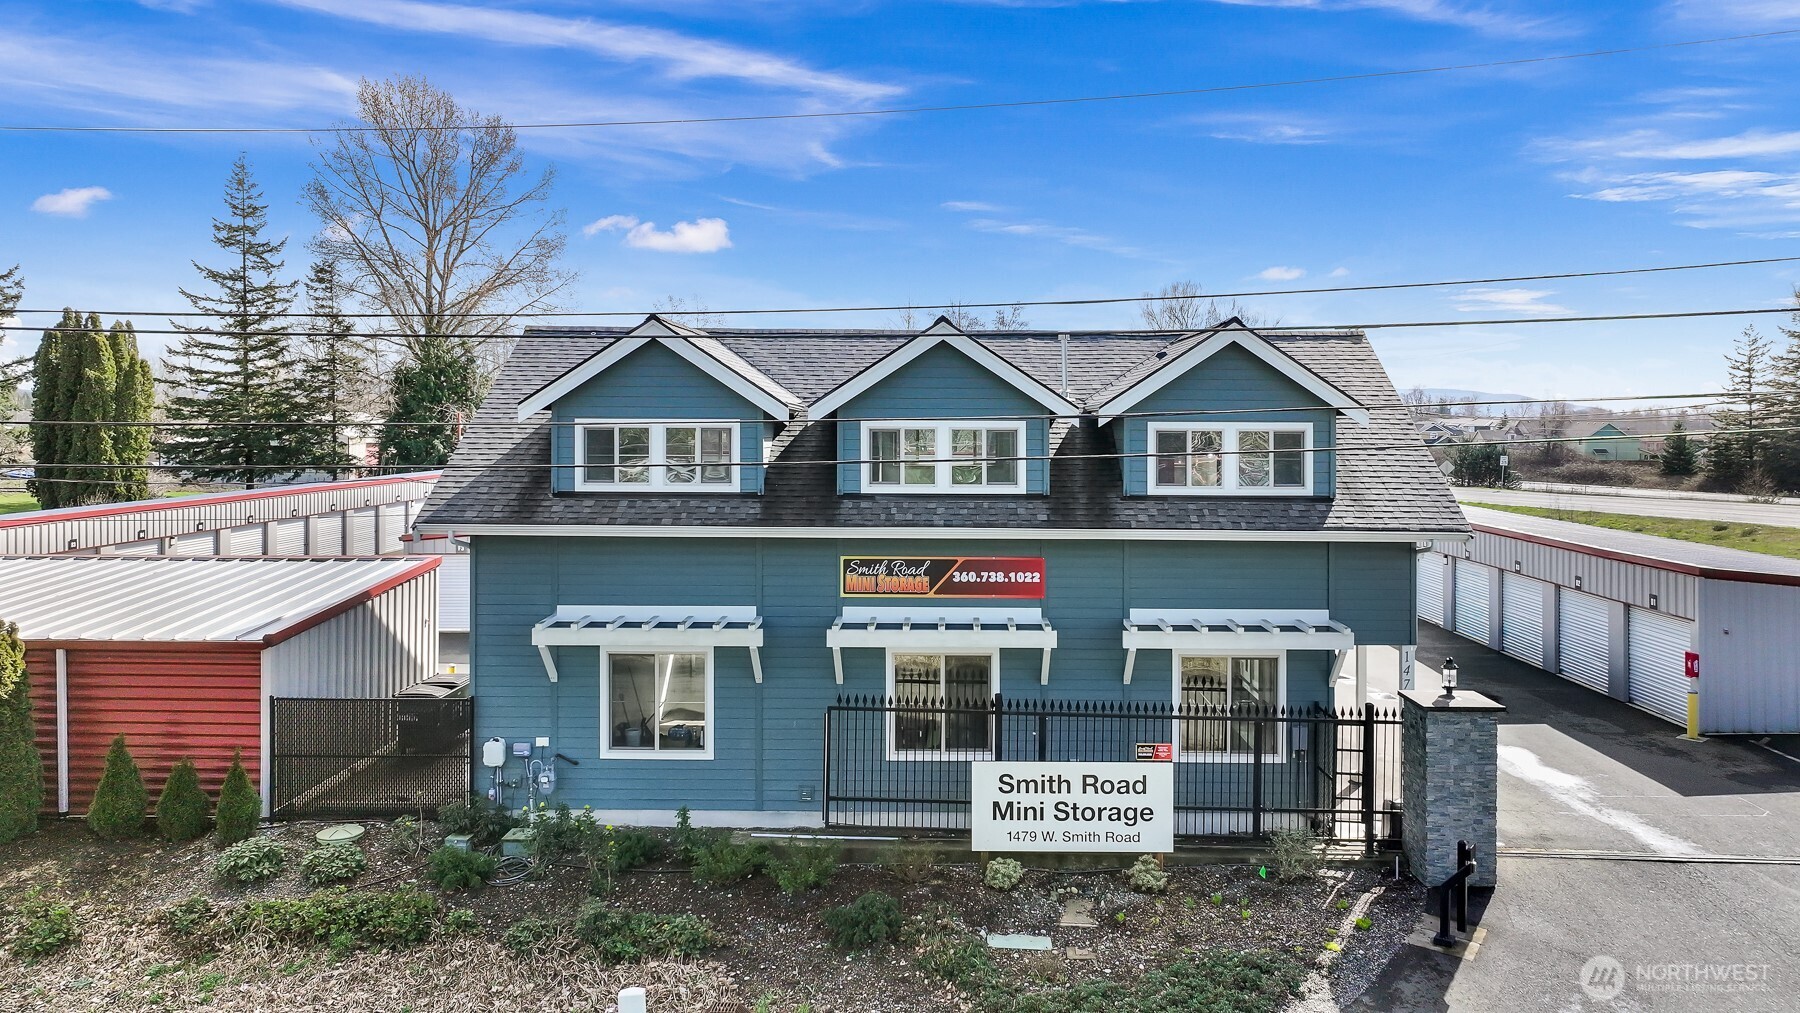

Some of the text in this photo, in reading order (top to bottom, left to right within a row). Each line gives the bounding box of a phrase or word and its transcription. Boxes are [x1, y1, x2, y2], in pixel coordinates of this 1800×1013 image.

[846, 560, 931, 578] Smith Road
[952, 571, 1040, 583] 360.738.1022
[845, 573, 930, 593] MINI STORAGE
[998, 773, 1147, 794] Smith Road
[992, 801, 1154, 826] Mini Storage
[1007, 831, 1141, 842] 1479 W. Smith Road
